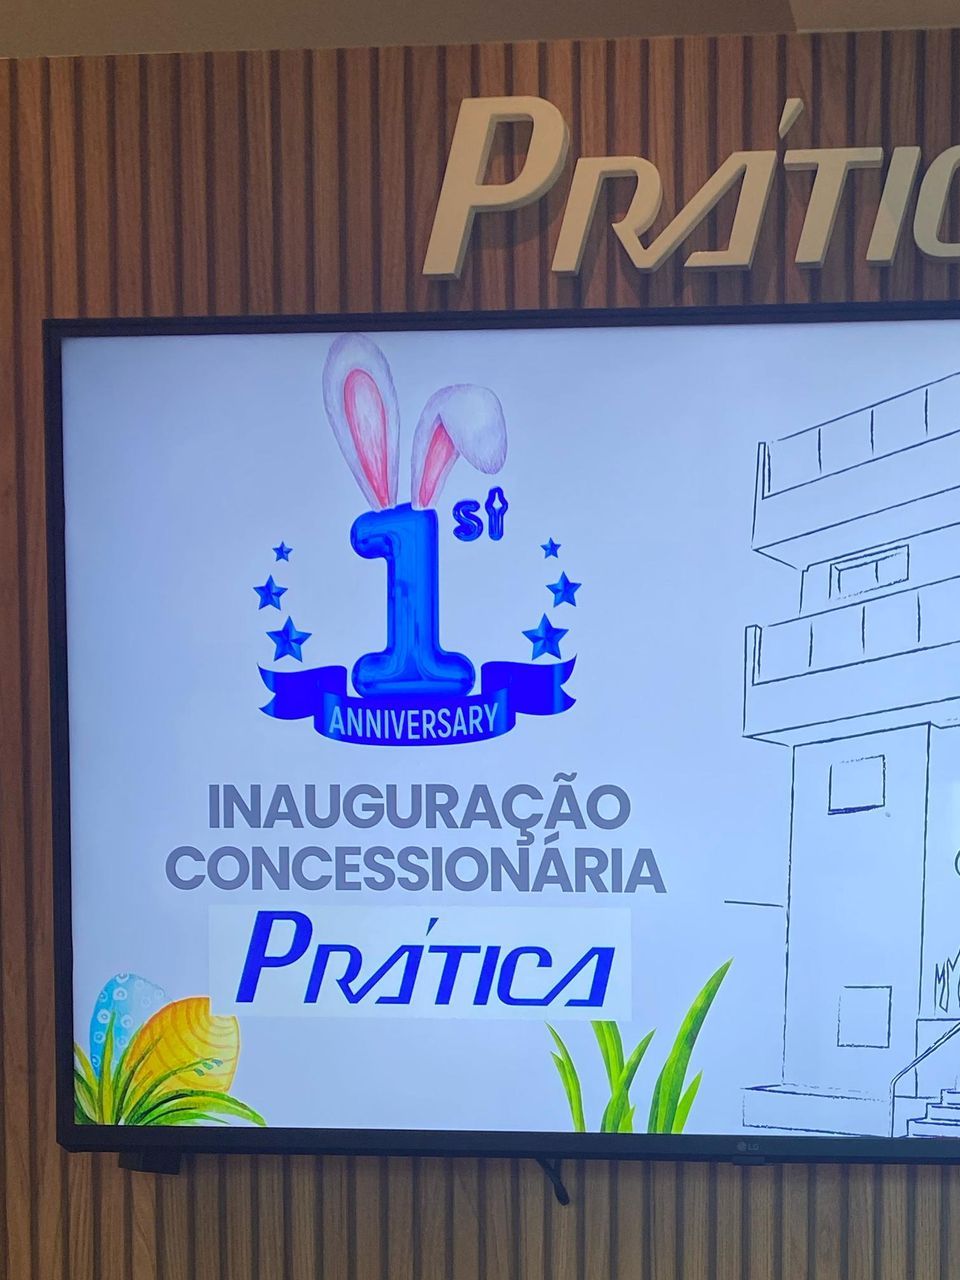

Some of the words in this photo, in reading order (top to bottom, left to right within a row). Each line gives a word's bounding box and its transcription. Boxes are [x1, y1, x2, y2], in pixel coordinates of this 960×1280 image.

[328, 702, 499, 740] ANNIVERSARY
[208, 771, 632, 846] INAUGURAÇÃO
[165, 831, 668, 894] CONCESSIONÁRIA
